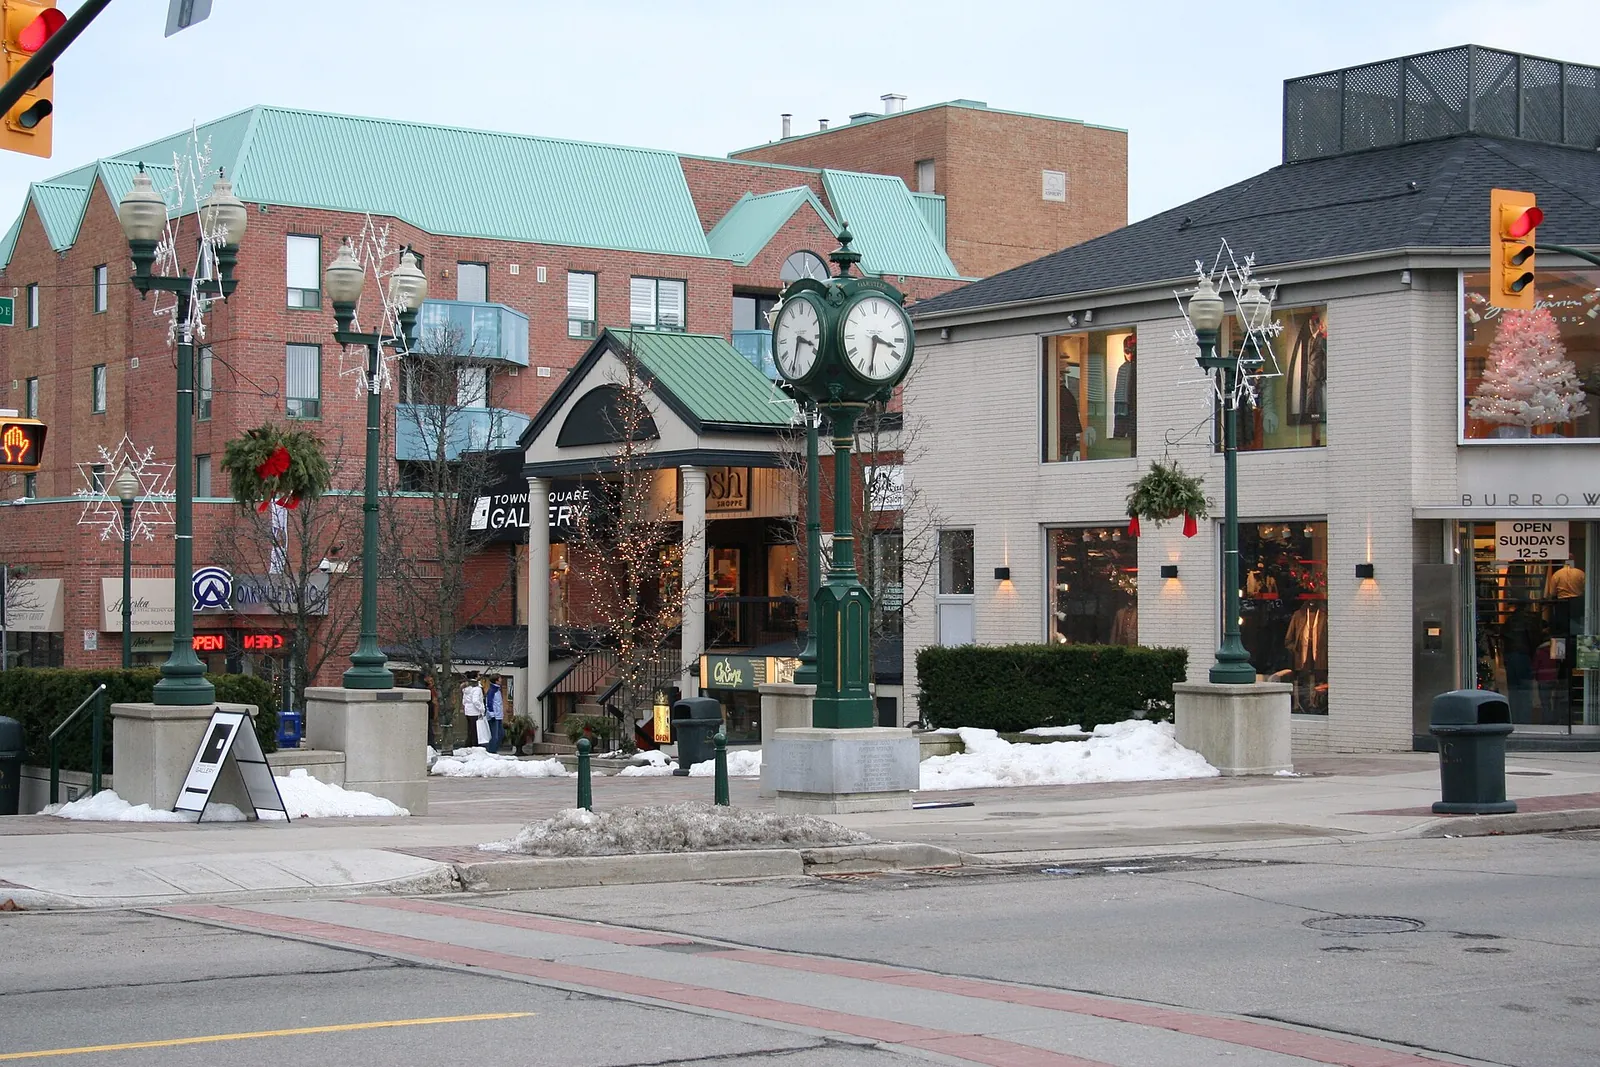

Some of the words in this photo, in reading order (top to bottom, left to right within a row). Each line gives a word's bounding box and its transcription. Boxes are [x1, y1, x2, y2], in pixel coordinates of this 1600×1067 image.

[494, 492, 530, 505] TOWN
[548, 490, 590, 502] QUARE
[1461, 492, 1600, 507] BURROW
[716, 500, 743, 508] SHOPPE
[490, 503, 589, 529] GALERY
[1512, 522, 1552, 533] OPEN
[1499, 535, 1566, 546] SUNDAYS
[1516, 548, 1548, 558] 12-5
